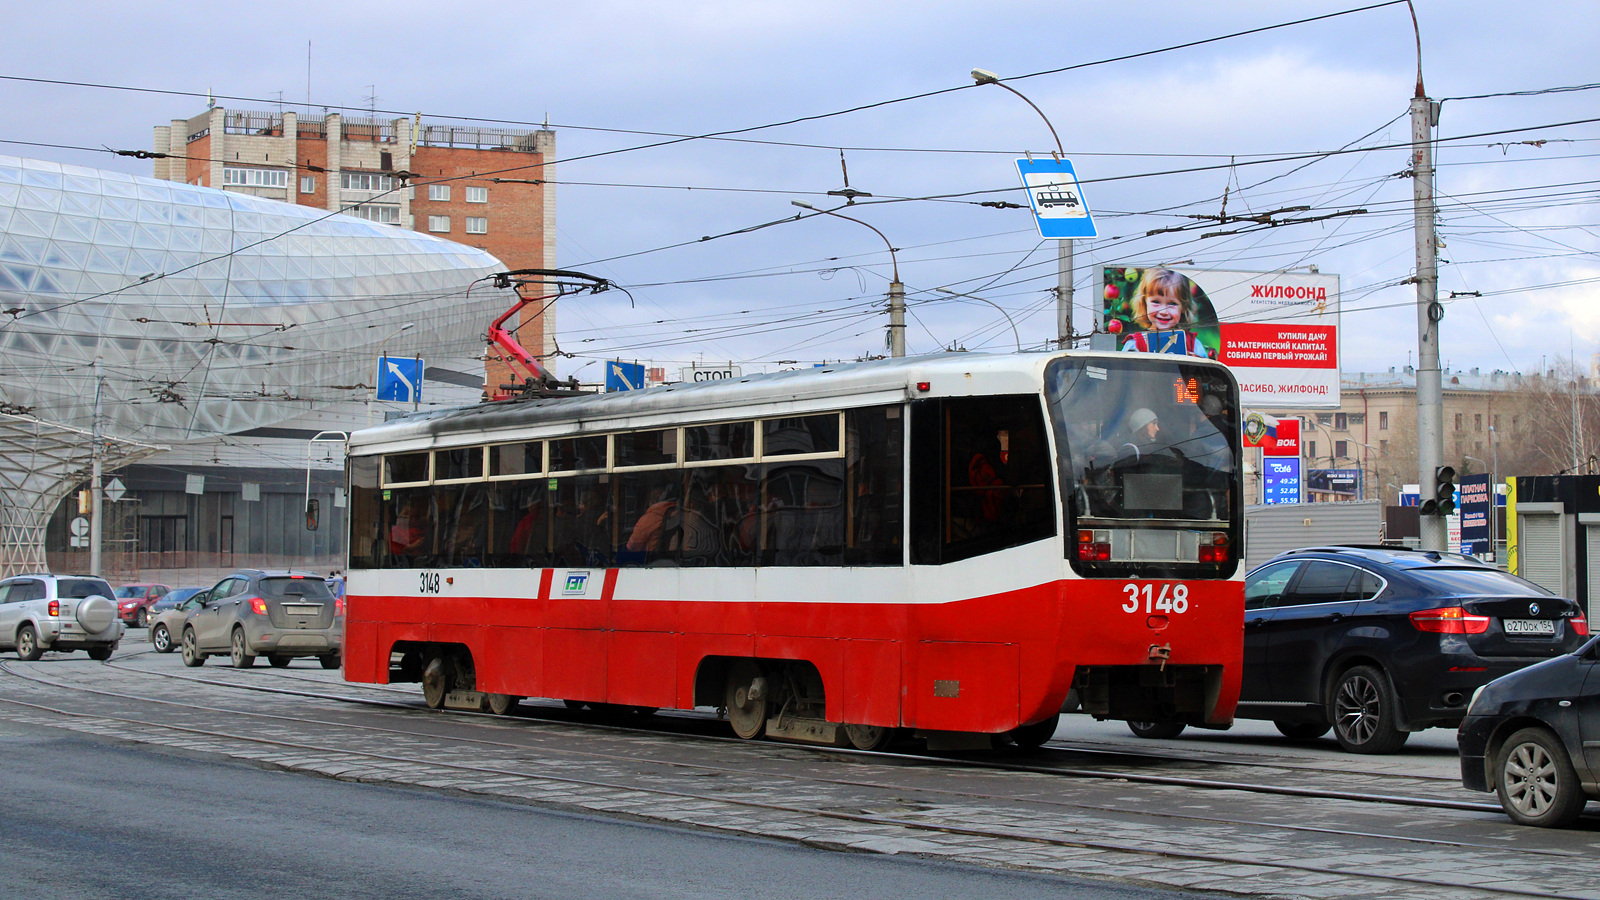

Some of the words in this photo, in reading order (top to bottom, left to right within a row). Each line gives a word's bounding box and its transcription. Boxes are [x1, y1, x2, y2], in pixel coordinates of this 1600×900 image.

[1250, 285, 1326, 301] ЖИЛФОНД
[1278, 332, 1307, 340] КУПИЛИ
[1308, 333, 1327, 341] ДАЧУ
[1238, 341, 1290, 350] МАТЕРИНСКИЙ
[1292, 343, 1327, 351] КАПИТАЛ.
[1226, 351, 1261, 359] СОБИРАЮ
[1263, 351, 1293, 360] ПЕРВЫЙ
[1295, 352, 1327, 360] УРОЖАЙ!
[693, 371, 732, 382] СТОП
[1173, 377, 1199, 403] 14
[1278, 384, 1329, 395] ЖИЛФОНД!
[1461, 483, 1487, 494] ПЛАТНАЯ
[1460, 493, 1488, 504] ПАРКОВКА
[420, 572, 440, 594] 3148
[1122, 583, 1188, 614] 3148
